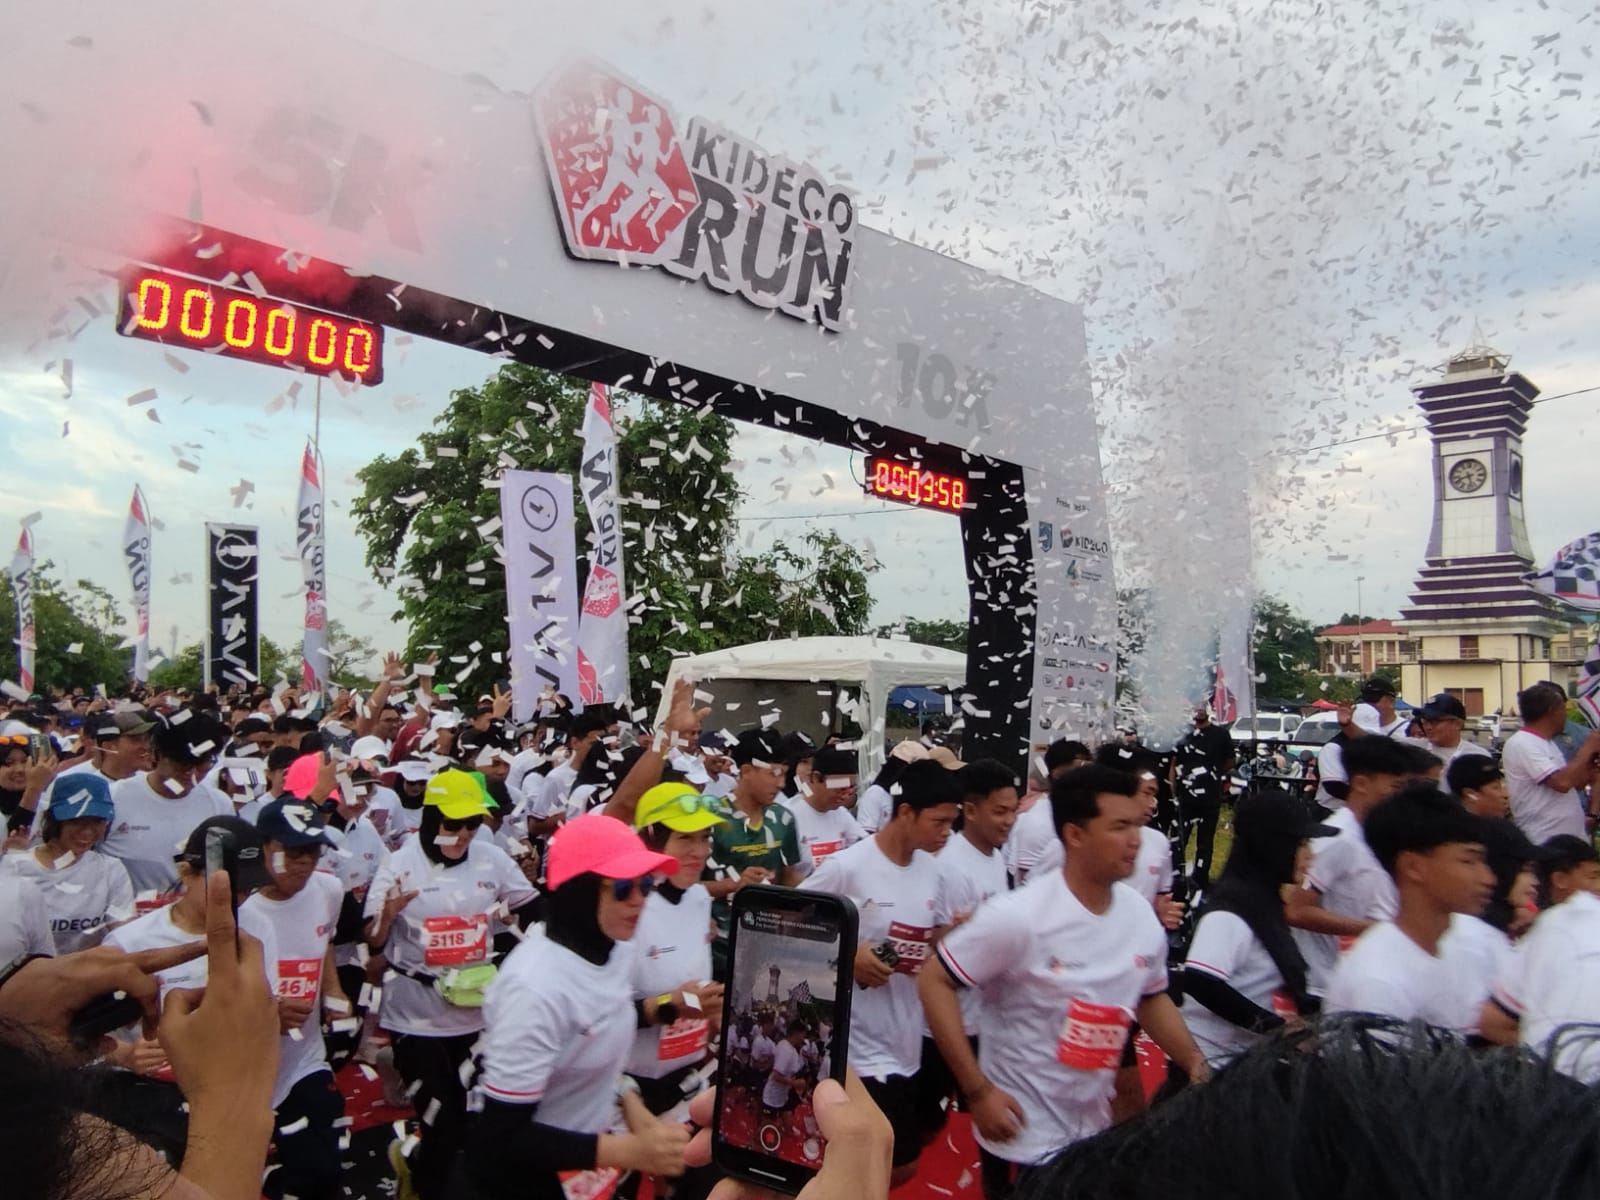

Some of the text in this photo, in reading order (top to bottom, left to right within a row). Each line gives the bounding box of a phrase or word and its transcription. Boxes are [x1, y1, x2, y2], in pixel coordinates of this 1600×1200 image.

[692, 125, 852, 234] KIDECO
[674, 172, 852, 322] RUN
[897, 342, 998, 436] 10K
[49, 916, 101, 931] IDECO
